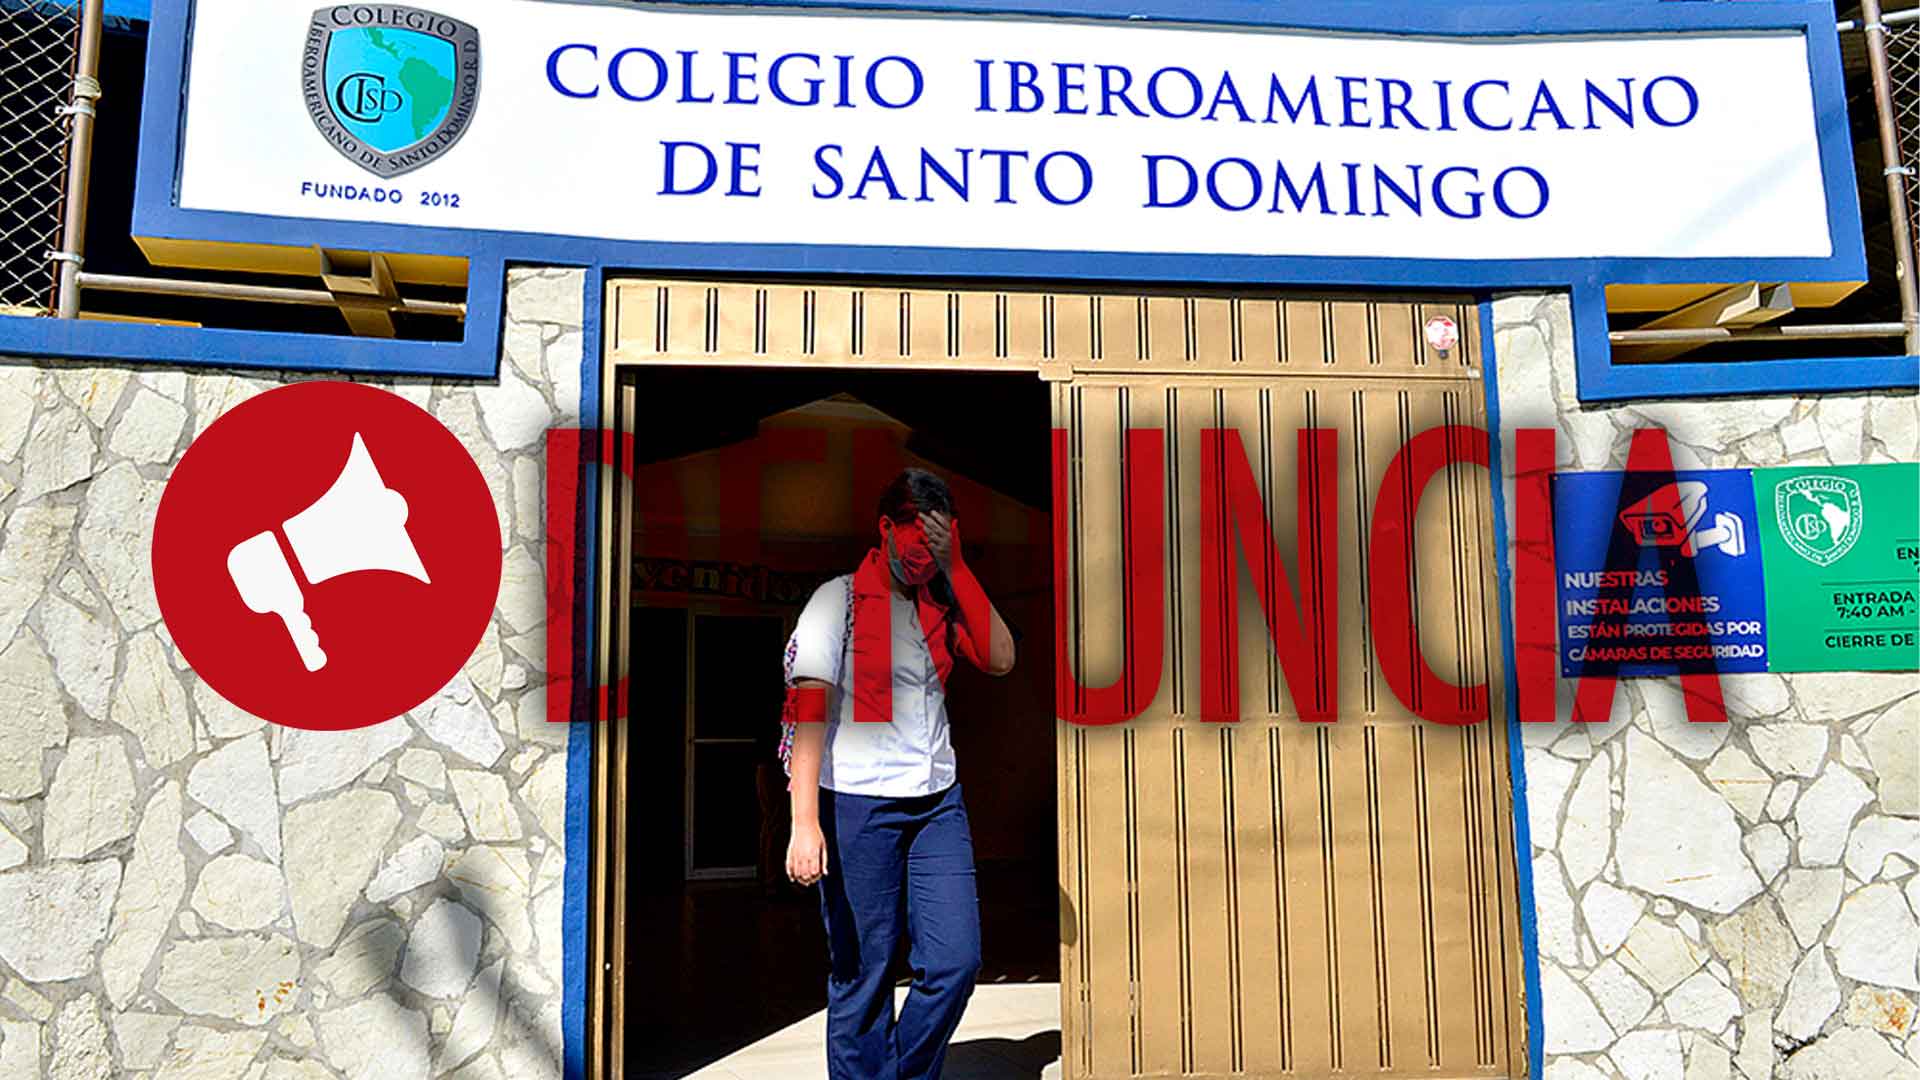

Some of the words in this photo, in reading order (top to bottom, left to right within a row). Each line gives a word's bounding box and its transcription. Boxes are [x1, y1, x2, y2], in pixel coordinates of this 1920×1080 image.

[331, 5, 457, 37] COLEGIO
[302, 20, 357, 153] IBEROAMERICANO
[360, 151, 384, 168] DE
[388, 141, 439, 170] SANTO
[437, 74, 477, 145] DOMINGO
[545, 43, 924, 109] COLEGIO
[974, 59, 1699, 132] IBEROAMERICANO
[656, 140, 762, 198] DE
[812, 143, 1093, 206] SANTO
[1141, 154, 1550, 220] DOMINGO
[301, 181, 403, 204] FUNDADO
[420, 191, 460, 209] 2012
[1564, 570, 1669, 589] NUESTRAS
[1566, 597, 1720, 616] INSTALACIONES
[1833, 591, 1916, 606] ENTRADA
[1836, 606, 1873, 619] 7:40
[1876, 605, 1905, 617] AM
[1568, 622, 1620, 639] ESTÁN
[1624, 622, 1725, 638] PROTEGIDAS
[1726, 621, 1761, 636] POR
[1825, 634, 1886, 649] CIERRE
[1890, 633, 1914, 647] DE
[1568, 645, 1648, 661] CÁMARAS
[1650, 646, 1673, 660] DE
[1674, 644, 1765, 660] SEGURIDAD
